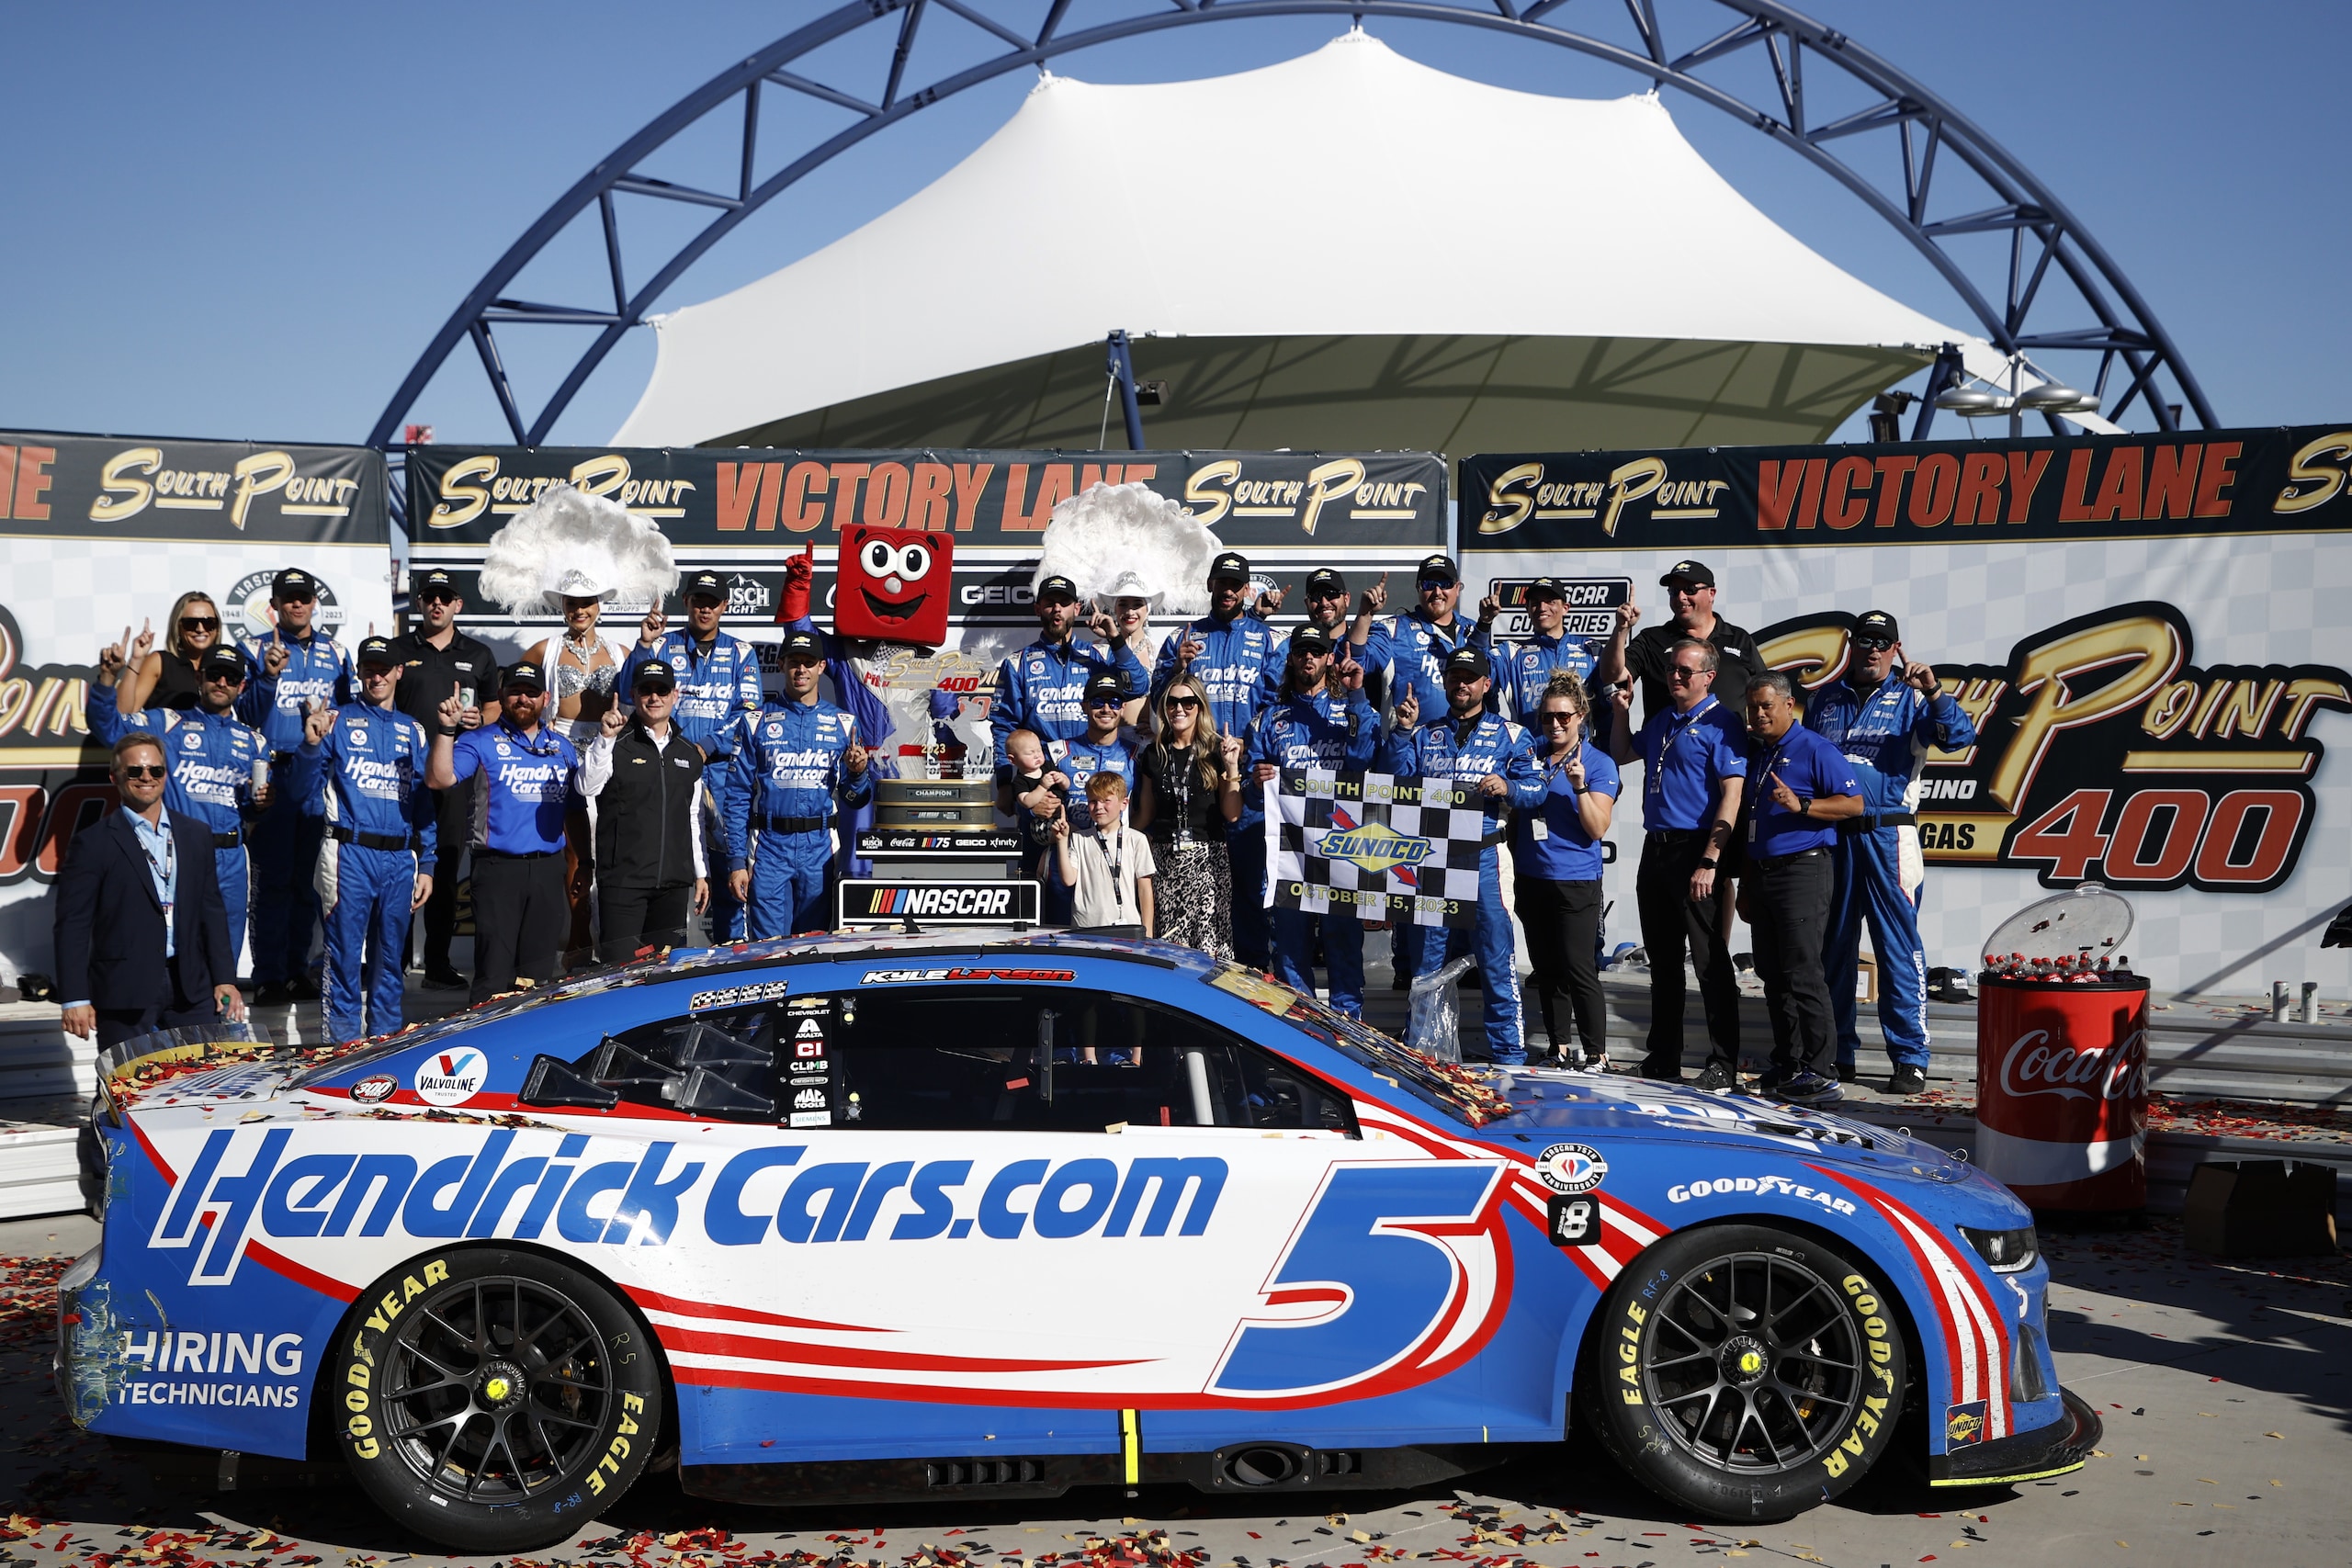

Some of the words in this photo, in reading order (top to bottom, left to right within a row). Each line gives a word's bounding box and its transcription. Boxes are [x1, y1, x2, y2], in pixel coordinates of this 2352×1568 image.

[0, 446, 58, 521] E
[88, 446, 232, 523] SOUTH
[229, 450, 360, 531] POINT
[716, 461, 996, 532] VICTORY
[1001, 463, 1158, 532] LA
[1183, 458, 1305, 526] SOUTH
[1301, 458, 1428, 536] POINT
[1757, 448, 2053, 531] VICTORY
[2058, 440, 2244, 524] LANE
[1477, 461, 1605, 536] SOUTH
[1601, 457, 1730, 538] POINT
[234, 571, 278, 599] NASC
[960, 585, 1033, 605] GEIC
[1564, 585, 1611, 605] SCAR
[1510, 615, 1536, 633] CU
[1564, 615, 1610, 634] ERIES
[937, 677, 979, 692] 400
[1988, 617, 2352, 816] POINT
[921, 743, 946, 754] 2023
[1422, 752, 1498, 774] Hendrick
[1294, 778, 1360, 797] SOUTH
[1366, 784, 1426, 802] POINT
[1430, 788, 1466, 805] 400
[1919, 779, 1978, 800] SINO
[862, 839, 883, 847] BUSCH
[935, 837, 951, 848] 75
[989, 837, 1018, 849] xfinity
[1324, 835, 1428, 861] SUNOCO
[1920, 823, 1976, 851] GAS
[2008, 789, 2307, 883] 400
[903, 888, 1011, 914] NASCAR
[1290, 883, 1377, 907] OCTOBER
[1383, 895, 1409, 911] 15,
[1415, 897, 1460, 915] 2023
[797, 1043, 823, 1056] CI
[1999, 1027, 2150, 1101] Coca-Co
[357, 1081, 392, 1094] 300
[420, 1076, 477, 1092] VALVOLINE
[794, 1088, 826, 1102] MAC
[1544, 1145, 1575, 1159] NASCAR
[1577, 1145, 1598, 1159] 75TH
[1544, 1173, 1600, 1191] ANNIVERSARY
[1667, 1175, 1858, 1216] GOODYEAR
[1562, 1201, 1591, 1238] 8
[1202, 1158, 1514, 1399] 5
[1642, 1269, 1670, 1300] RF-8
[2005, 1275, 2029, 1319] 5
[120, 1331, 303, 1376] HIRING
[1619, 1300, 1647, 1405] EAGLE
[119, 1382, 300, 1408] TECHNICIANS
[585, 1392, 645, 1496] EAGLE
